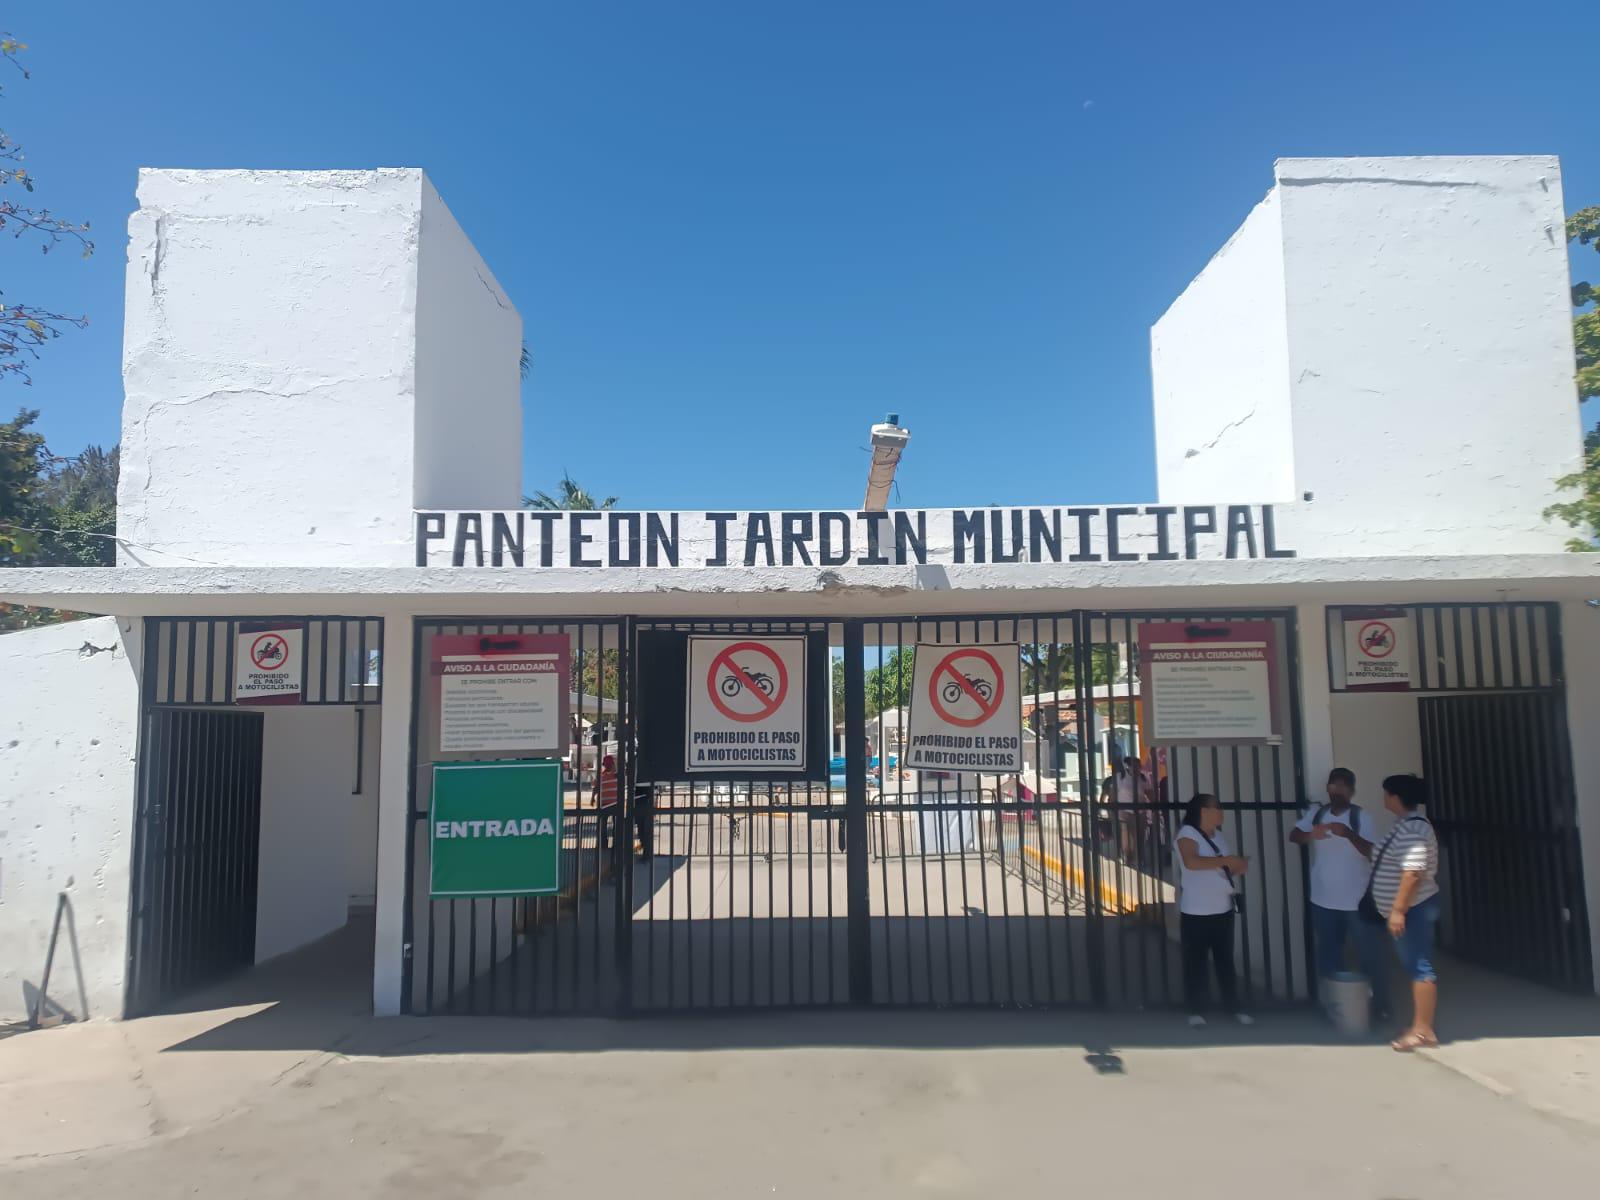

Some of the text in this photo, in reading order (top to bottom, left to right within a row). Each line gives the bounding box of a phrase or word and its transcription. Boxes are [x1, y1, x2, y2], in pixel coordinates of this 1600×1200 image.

[415, 504, 1298, 568] PANTEON JARDIN MUNICIPAL
[1152, 650, 1265, 660] AVISO A LA CIUDADANÍA
[443, 661, 556, 673] AVISO A LA CIUDADANÍA
[693, 731, 801, 744] PROHIBIDO EL PASO
[912, 734, 1018, 750] PROHIBIDO EL PASO
[697, 748, 797, 761] A MOTOCICLISTAS
[914, 750, 1014, 766] A MOTOCICLISTAS
[435, 818, 554, 839] ENTRADA
